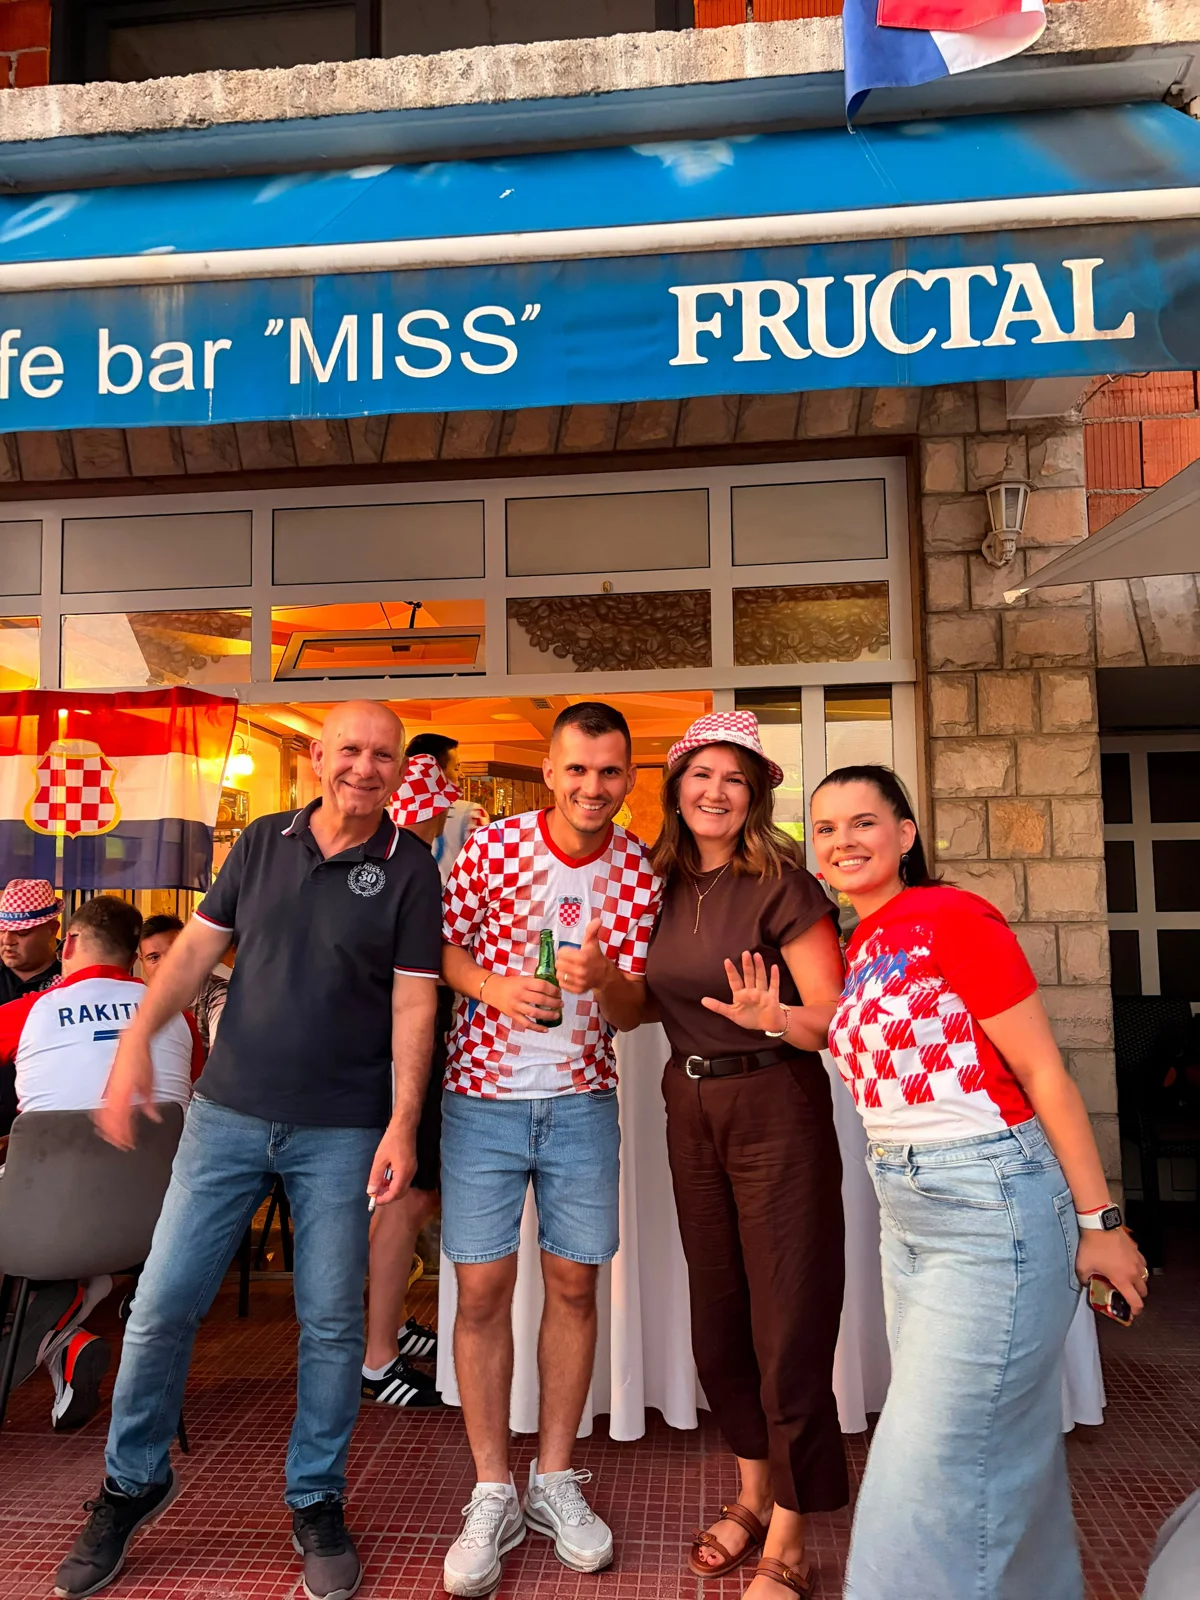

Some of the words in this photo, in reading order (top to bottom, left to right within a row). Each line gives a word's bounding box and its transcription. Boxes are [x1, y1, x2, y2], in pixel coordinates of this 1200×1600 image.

[668, 257, 1136, 366] FRUCTAL
[99, 328, 233, 395] bar
[358, 870, 377, 883] 30
